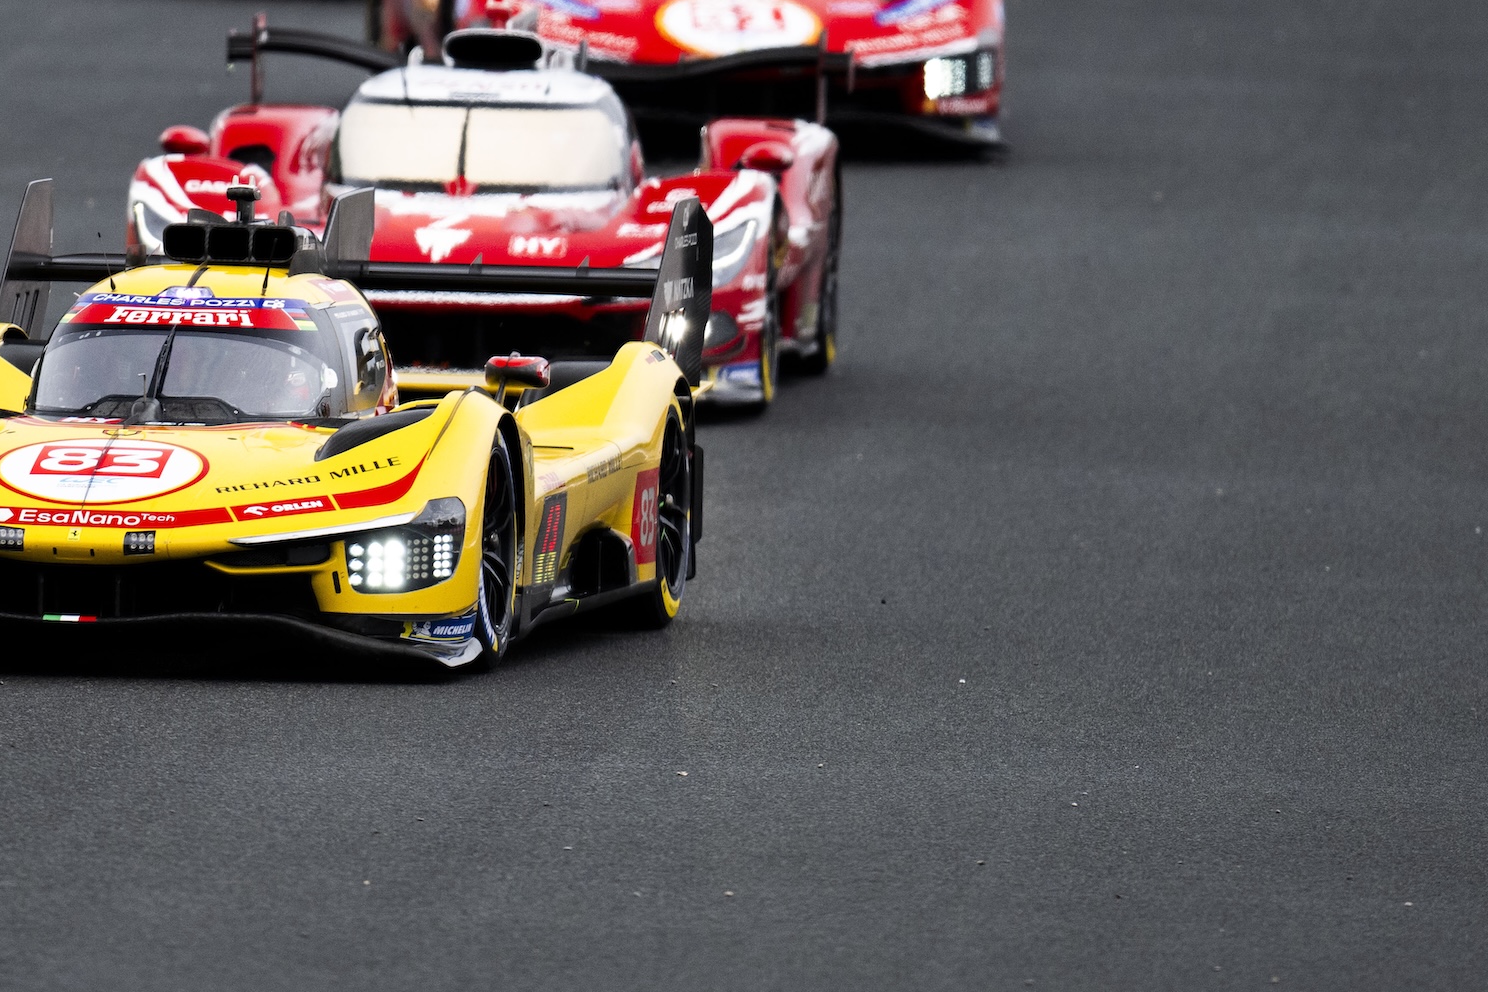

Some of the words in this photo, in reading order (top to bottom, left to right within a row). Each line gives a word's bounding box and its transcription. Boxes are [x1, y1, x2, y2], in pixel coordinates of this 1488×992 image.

[92, 293, 184, 306] CHARLES
[193, 298, 256, 308] POZZI
[104, 305, 254, 327] Ferrari
[39, 447, 164, 475] 83
[215, 475, 322, 494] RICHARD
[329, 456, 402, 480] MILLE
[271, 500, 324, 513] ORLEN
[639, 487, 655, 547] 83
[432, 622, 473, 636] MICHELIN
